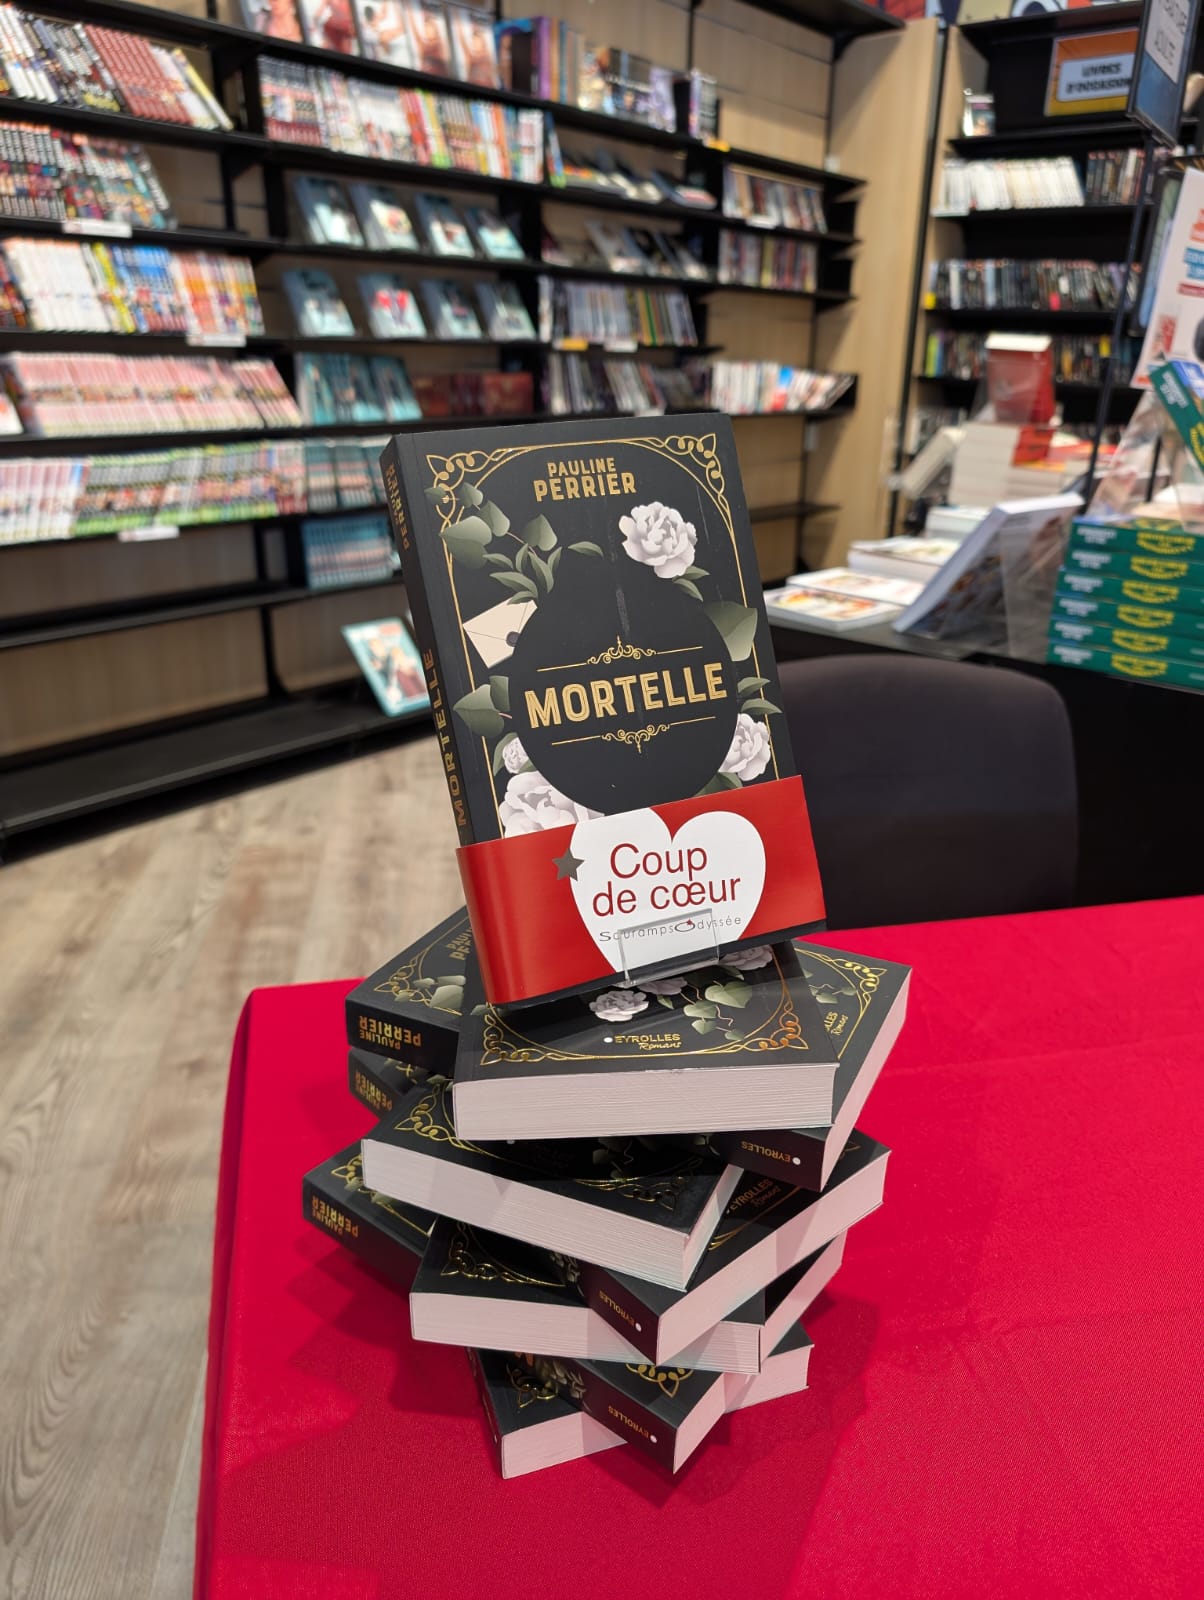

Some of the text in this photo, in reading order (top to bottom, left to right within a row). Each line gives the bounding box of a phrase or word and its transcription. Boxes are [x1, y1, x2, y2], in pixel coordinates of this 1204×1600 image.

[547, 457, 616, 478] PAULINE
[533, 472, 637, 502] PERRIER
[524, 662, 727, 729] MORTELLE
[423, 648, 467, 826] MORTELLE
[610, 842, 708, 881] Coup
[592, 878, 741, 917] de cœur
[359, 1015, 422, 1047] PERRIER
[359, 1029, 401, 1050] PAULINE
[615, 1033, 681, 1044] EYROLLES
[638, 1041, 682, 1051] Romans
[355, 1070, 393, 1112] PERRIER
[741, 1140, 791, 1162] EYROLLES
[312, 1195, 359, 1238] PERRIER
[599, 1290, 635, 1327] EYROLLES
[608, 1405, 649, 1439] EYROLLES
